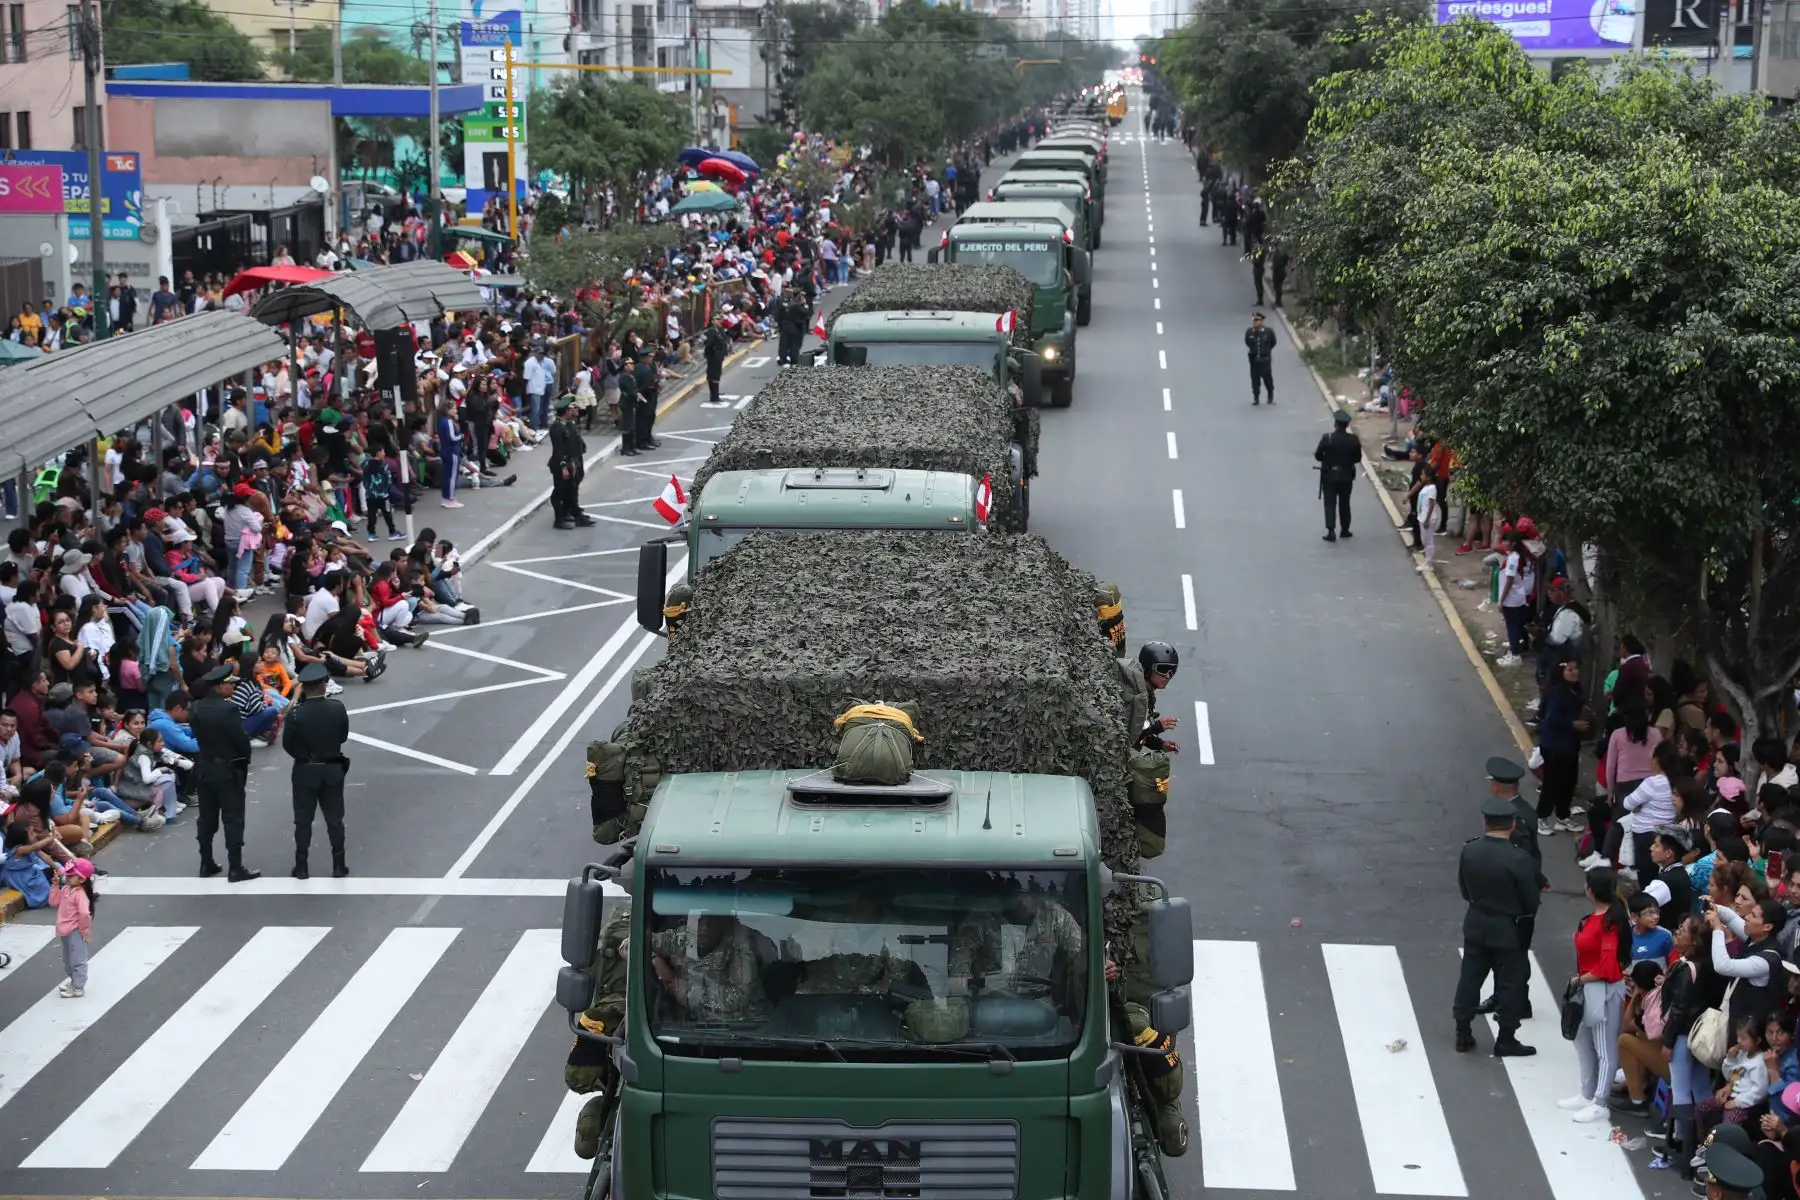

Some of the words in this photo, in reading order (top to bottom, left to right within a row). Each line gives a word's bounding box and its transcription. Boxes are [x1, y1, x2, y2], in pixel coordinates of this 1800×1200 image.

[1448, 0, 1553, 18] arriesgues!
[72, 173, 88, 183] TU
[960, 243, 1003, 252] EJERCITO
[1005, 243, 1022, 252] DEL
[1024, 243, 1048, 252] PERU
[808, 1138, 921, 1160] MAN
